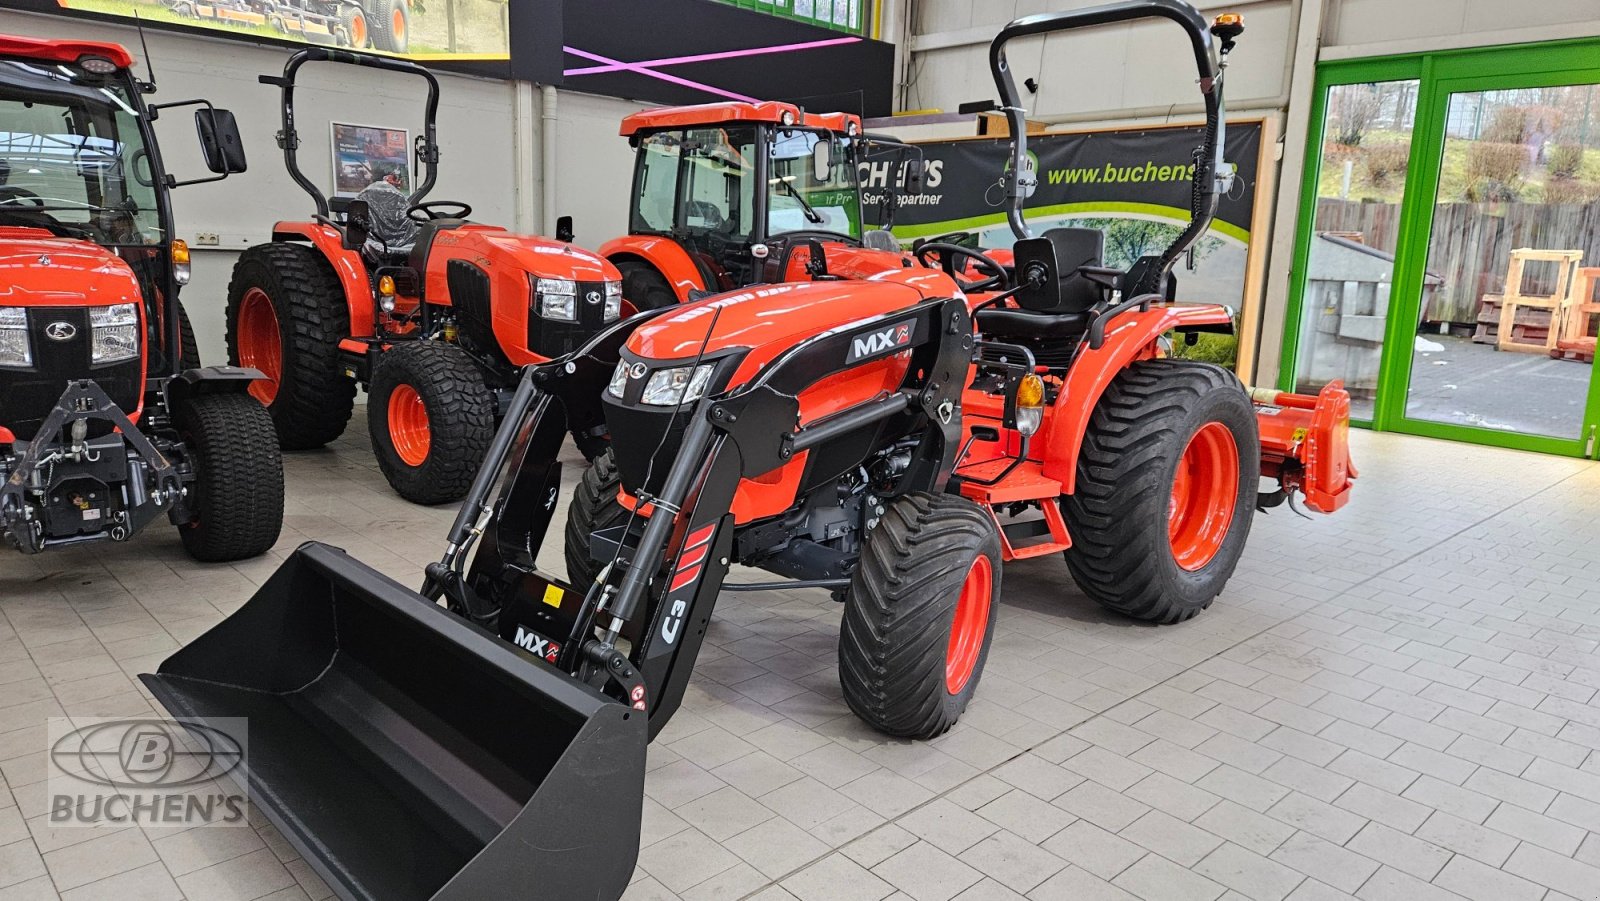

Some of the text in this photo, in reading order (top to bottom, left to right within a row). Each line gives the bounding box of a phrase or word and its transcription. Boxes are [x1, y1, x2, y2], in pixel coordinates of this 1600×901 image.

[854, 328, 895, 358] MX
[661, 599, 687, 644] C3
[514, 627, 549, 657] MX
